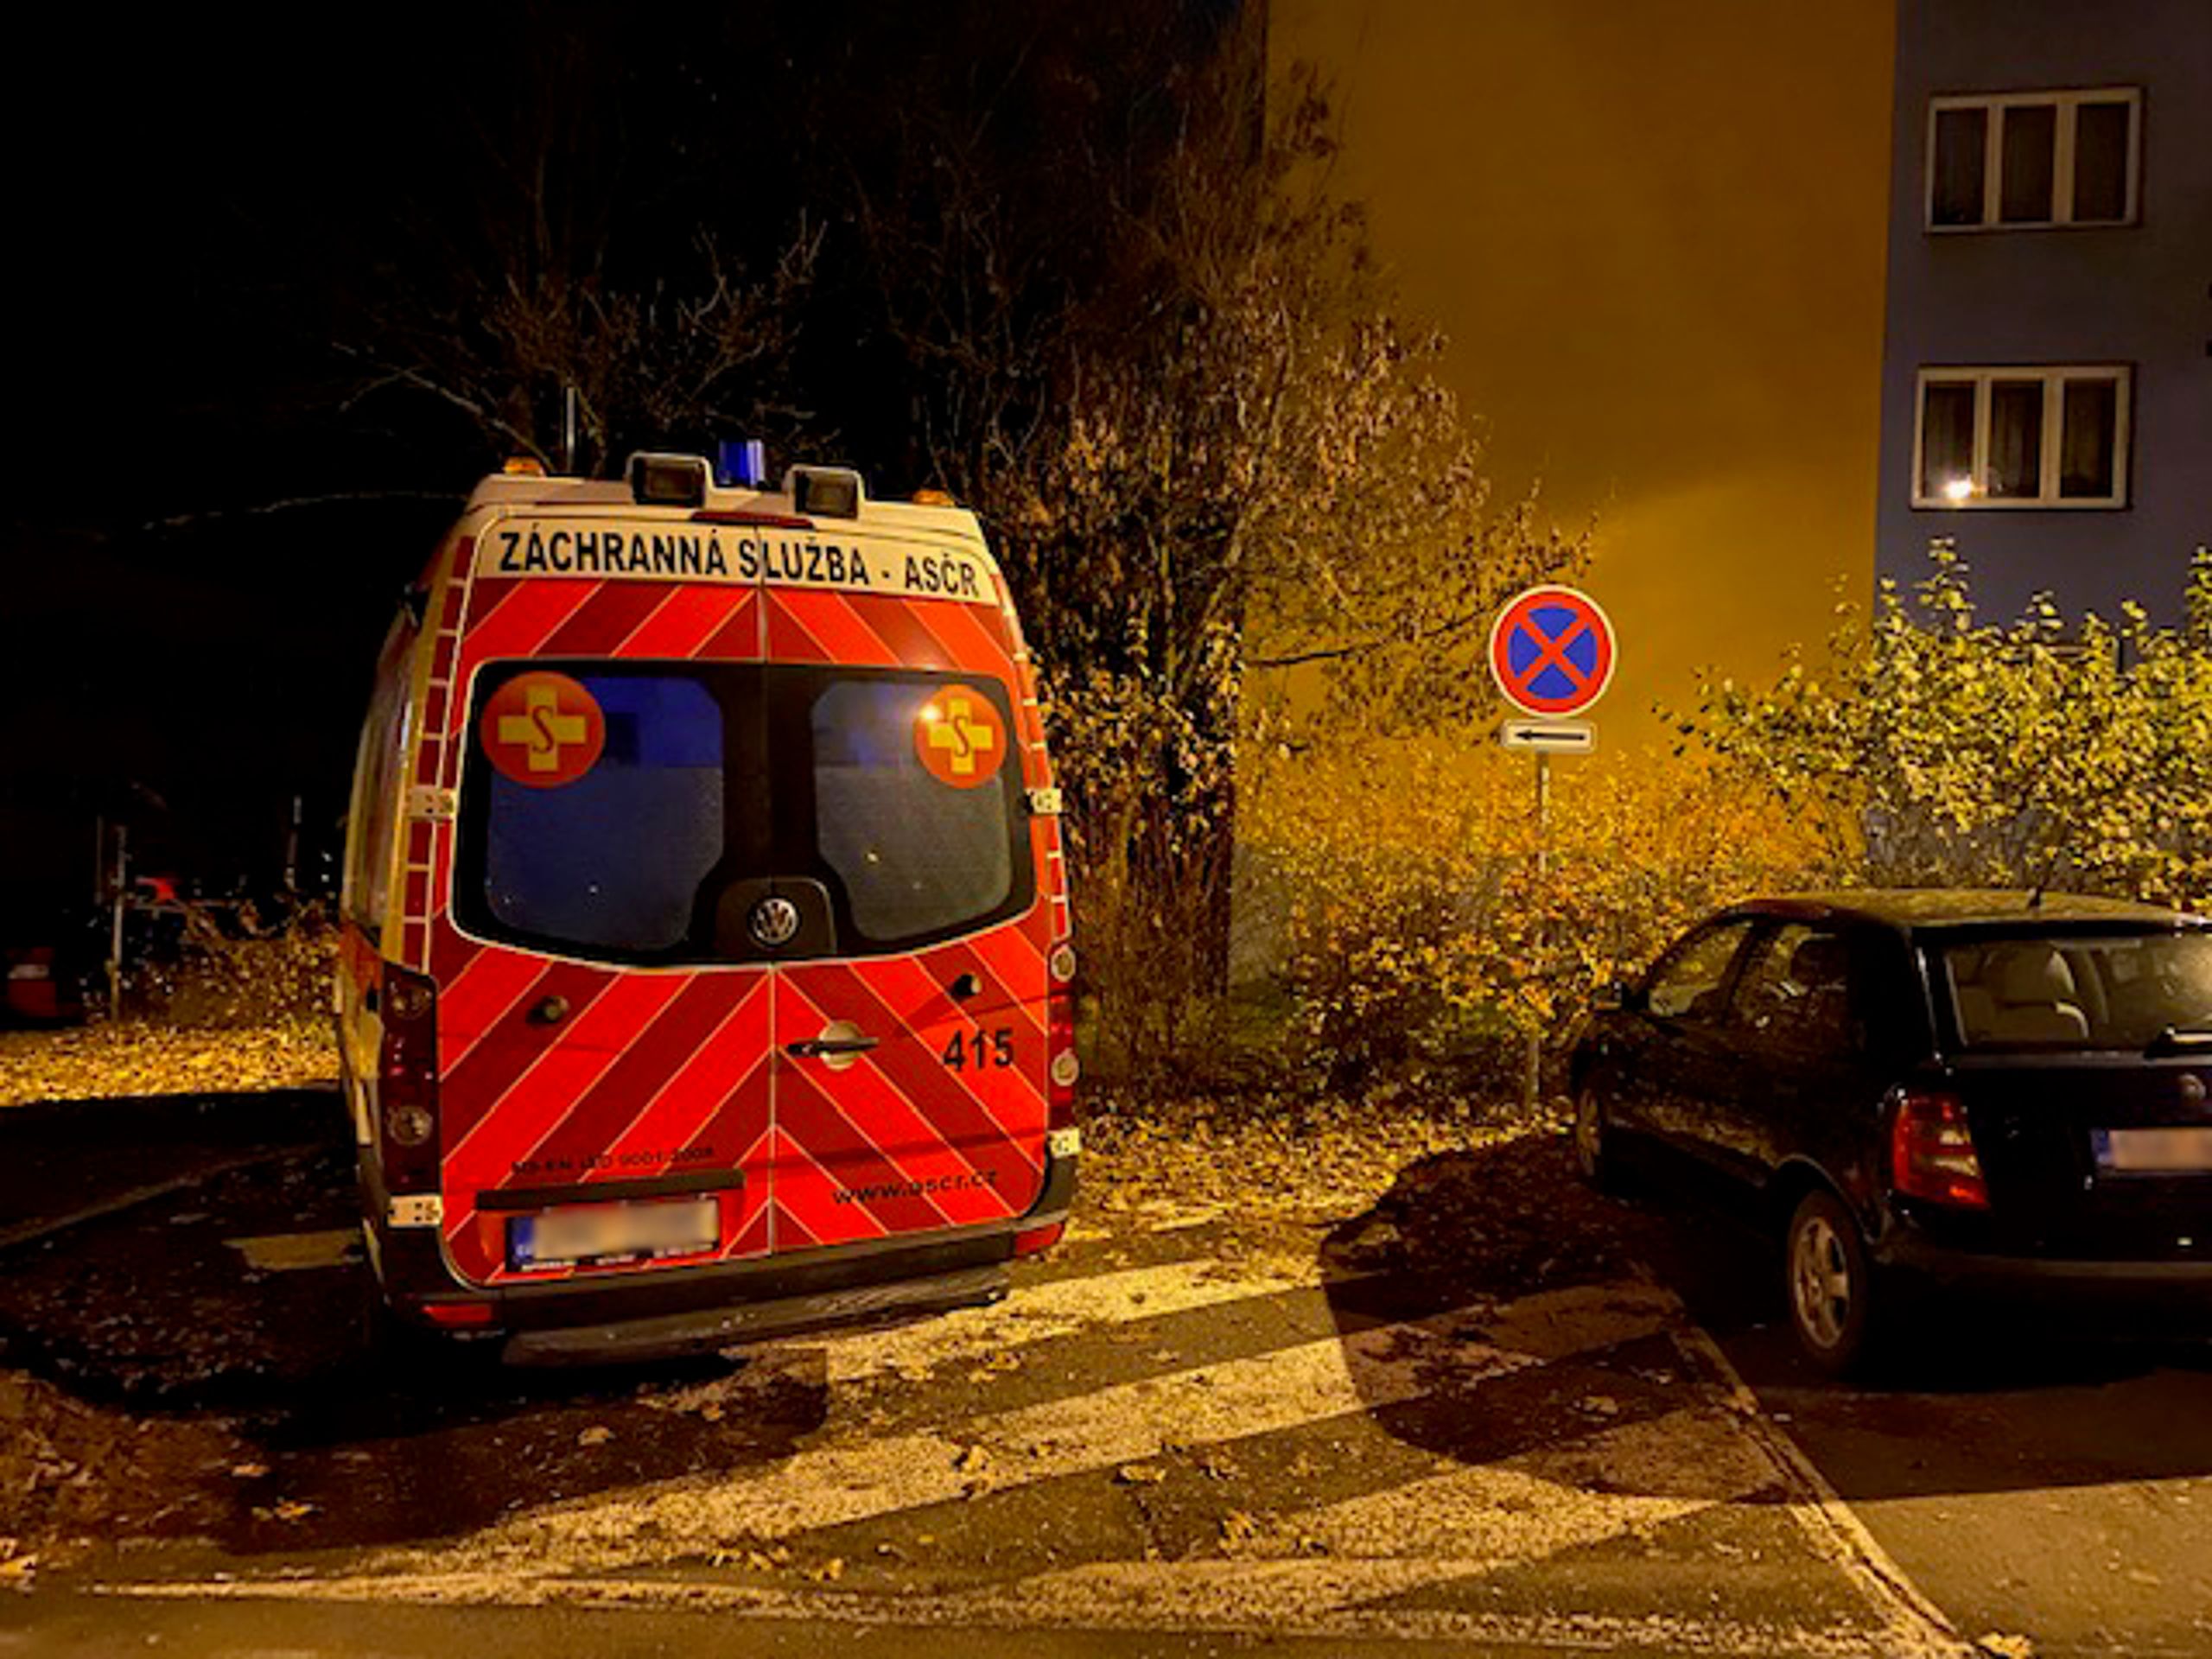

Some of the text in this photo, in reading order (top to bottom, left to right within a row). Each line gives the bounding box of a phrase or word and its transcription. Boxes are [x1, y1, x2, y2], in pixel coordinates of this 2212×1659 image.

[499, 524, 728, 576] ZÁCHRANNÁ
[739, 536, 870, 586] SLUŽBA
[904, 553, 980, 597] ASČR
[944, 1028, 1014, 1071] 415
